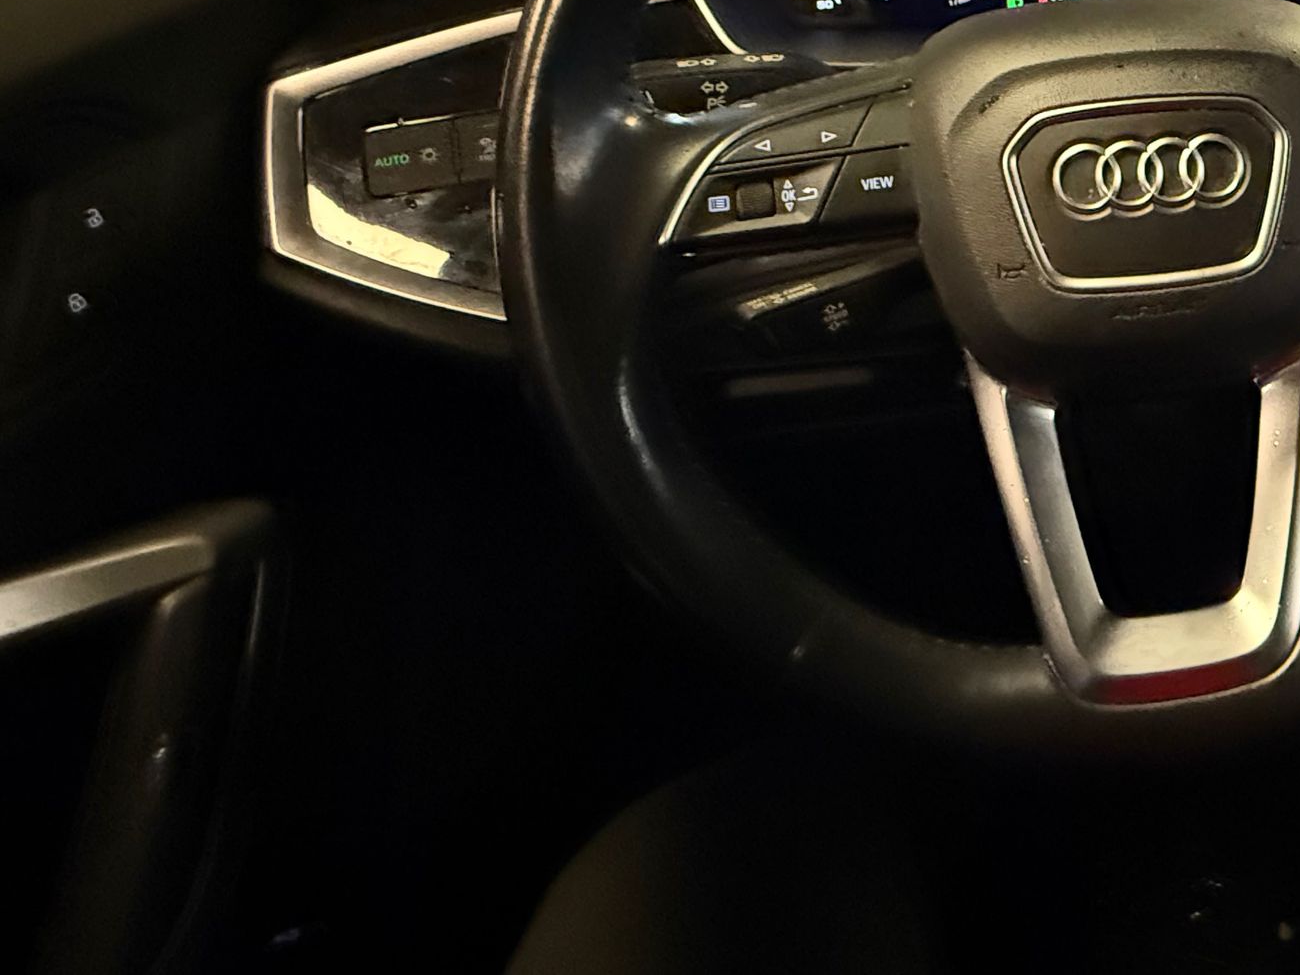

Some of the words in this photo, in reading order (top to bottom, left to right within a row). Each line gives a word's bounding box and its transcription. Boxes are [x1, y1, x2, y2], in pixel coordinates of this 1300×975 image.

[374, 153, 410, 167] AUTO
[860, 175, 894, 191] VIEW
[781, 190, 796, 202] OK
